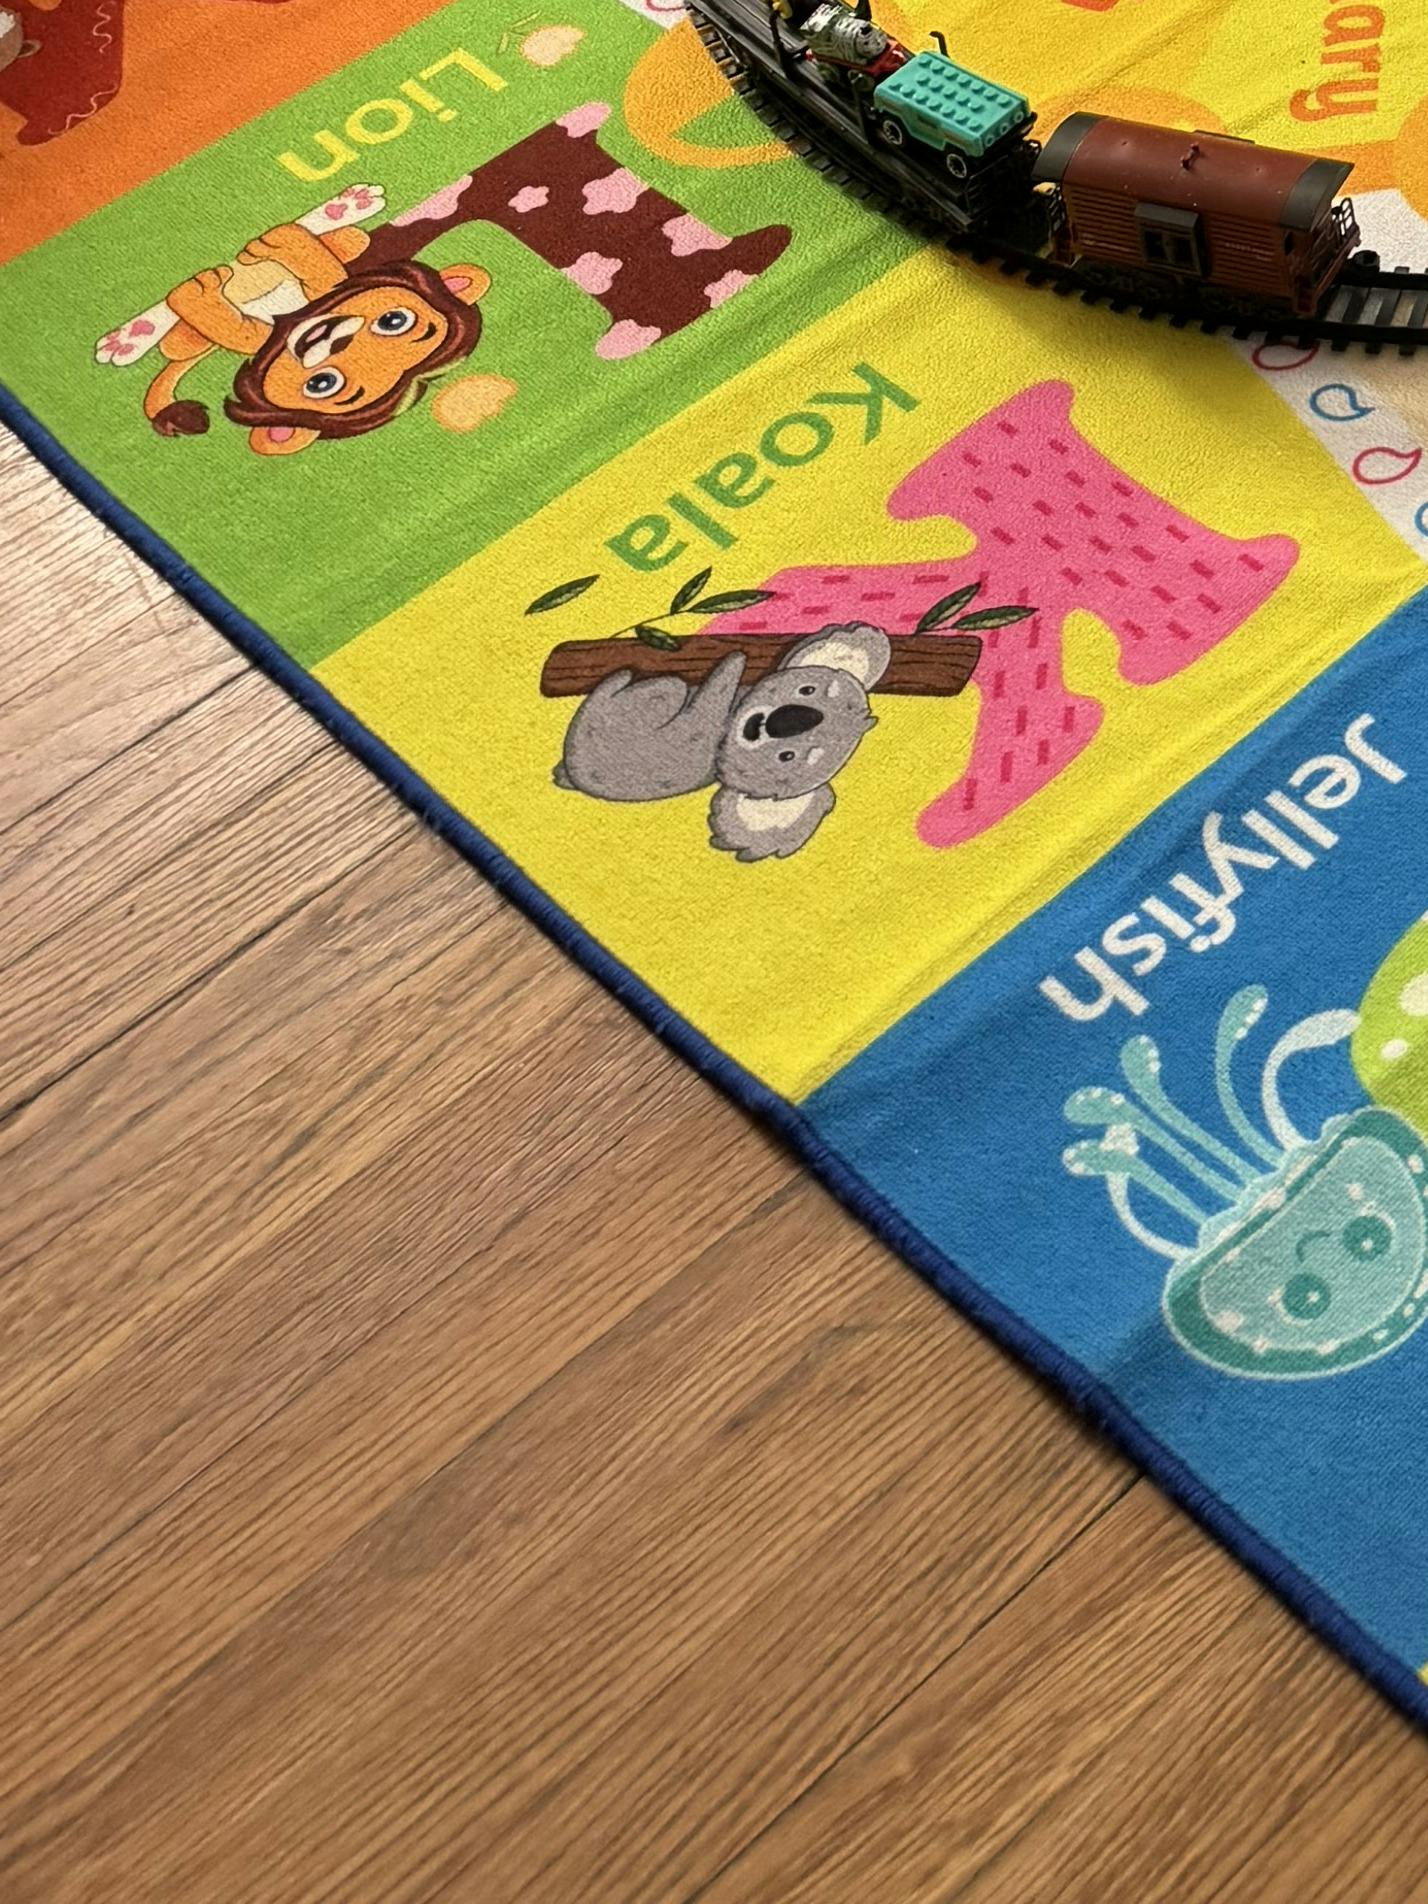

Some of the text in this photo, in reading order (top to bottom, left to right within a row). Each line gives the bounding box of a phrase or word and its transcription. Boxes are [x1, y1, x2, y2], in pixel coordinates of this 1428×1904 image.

[276, 30, 509, 184] Lion
[606, 360, 918, 574] Koala
[1039, 712, 1408, 1022] Jellyfish
